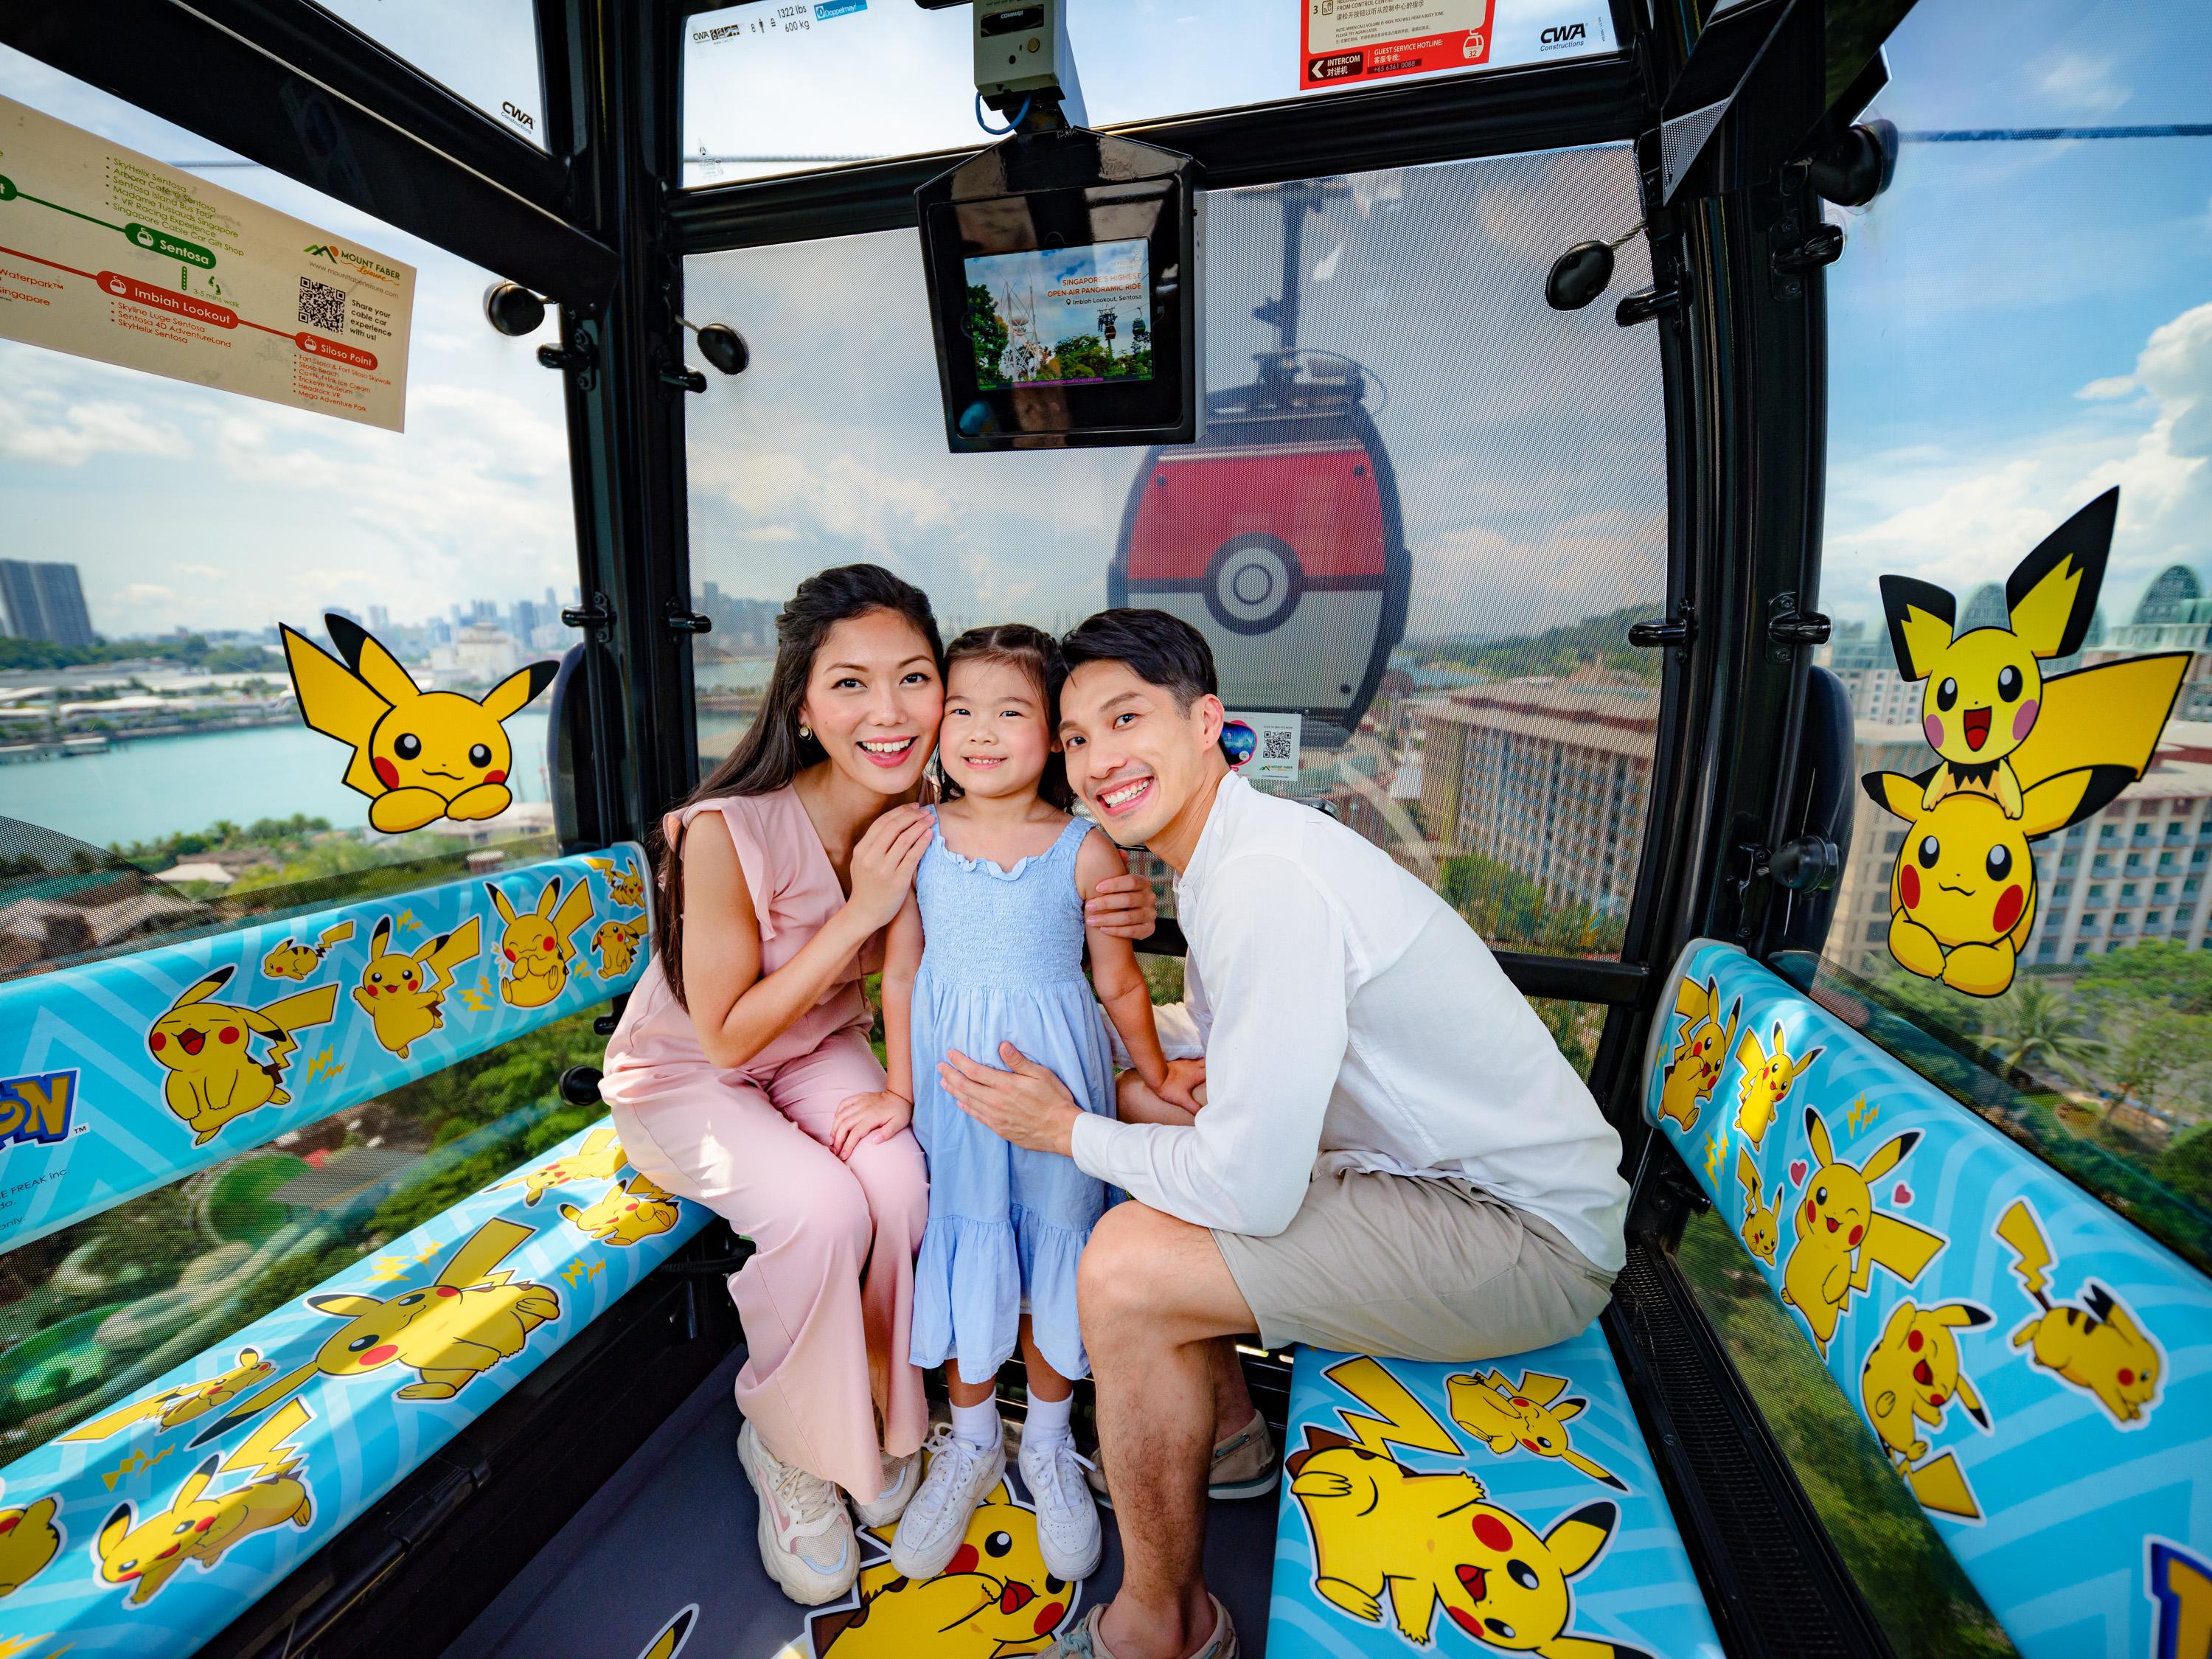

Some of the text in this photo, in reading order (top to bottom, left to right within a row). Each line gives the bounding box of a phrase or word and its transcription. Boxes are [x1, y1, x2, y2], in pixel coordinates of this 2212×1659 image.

[777, 5, 807, 18] 1322 lbs
[824, 4, 856, 16] Doppelmayr
[1313, 5, 1318, 14] 3
[1351, 1, 1374, 9] CONTROL
[1001, 10, 1024, 19] COMMAX
[751, 24, 756, 32] 8
[785, 19, 810, 32] 600 kg
[1540, 23, 1586, 44] CWA
[693, 31, 710, 41] CWA
[1374, 39, 1443, 55] GUEST SERVICE HOTLINE:
[1540, 41, 1584, 52] Constructions
[1327, 55, 1360, 66] INTERCOM
[1385, 63, 1399, 72] 6361
[1327, 66, 1348, 77] 对讲机
[501, 111, 532, 135] Constructions
[502, 101, 534, 130] CWA
[114, 157, 187, 192] SkyHelix Sentosa
[113, 168, 146, 186] Arbora
[183, 194, 216, 213] Sentosa
[113, 176, 213, 220] Sentosa Island Bus Tour
[113, 186, 239, 238] Madame Tussauds Singapore
[122, 197, 133, 206] VR
[136, 202, 167, 221] Racing
[170, 215, 216, 237] Experience
[113, 203, 244, 257] Singapore Cable Car Gift Shop
[160, 240, 209, 265] Sentosa
[341, 250, 400, 280] MOUNT FABER
[1110, 273, 1141, 282] HIGHEST
[193, 288, 240, 308] 3-5 mins walk
[1047, 288, 1080, 297] OPEN-AIR
[1081, 285, 1123, 294] PANORAMIC
[135, 288, 231, 324] Imbiah Lookout
[352, 299, 391, 319] Share your
[118, 302, 206, 333] Skyline Luge Sentosa
[351, 310, 387, 326] cable car
[118, 310, 232, 348] Sentosa 4D AdventureLand
[118, 319, 188, 344] SkyHelix Sentosa
[349, 328, 377, 341] with us!
[350, 319, 392, 337] experience
[321, 344, 372, 366] Siloso Point
[299, 362, 339, 378] Siloso Beach
[313, 358, 330, 368] Siloso
[338, 366, 350, 374] Fort
[352, 369, 368, 379] Siloso
[369, 375, 391, 386] Skywalk
[299, 375, 353, 394] Trickeye Museum
[299, 383, 331, 395] Headrock
[349, 383, 370, 393] Cream
[298, 390, 319, 400] Mega
[320, 396, 352, 408] Adventure
[12, 1169, 71, 1194] FREAK inc.
